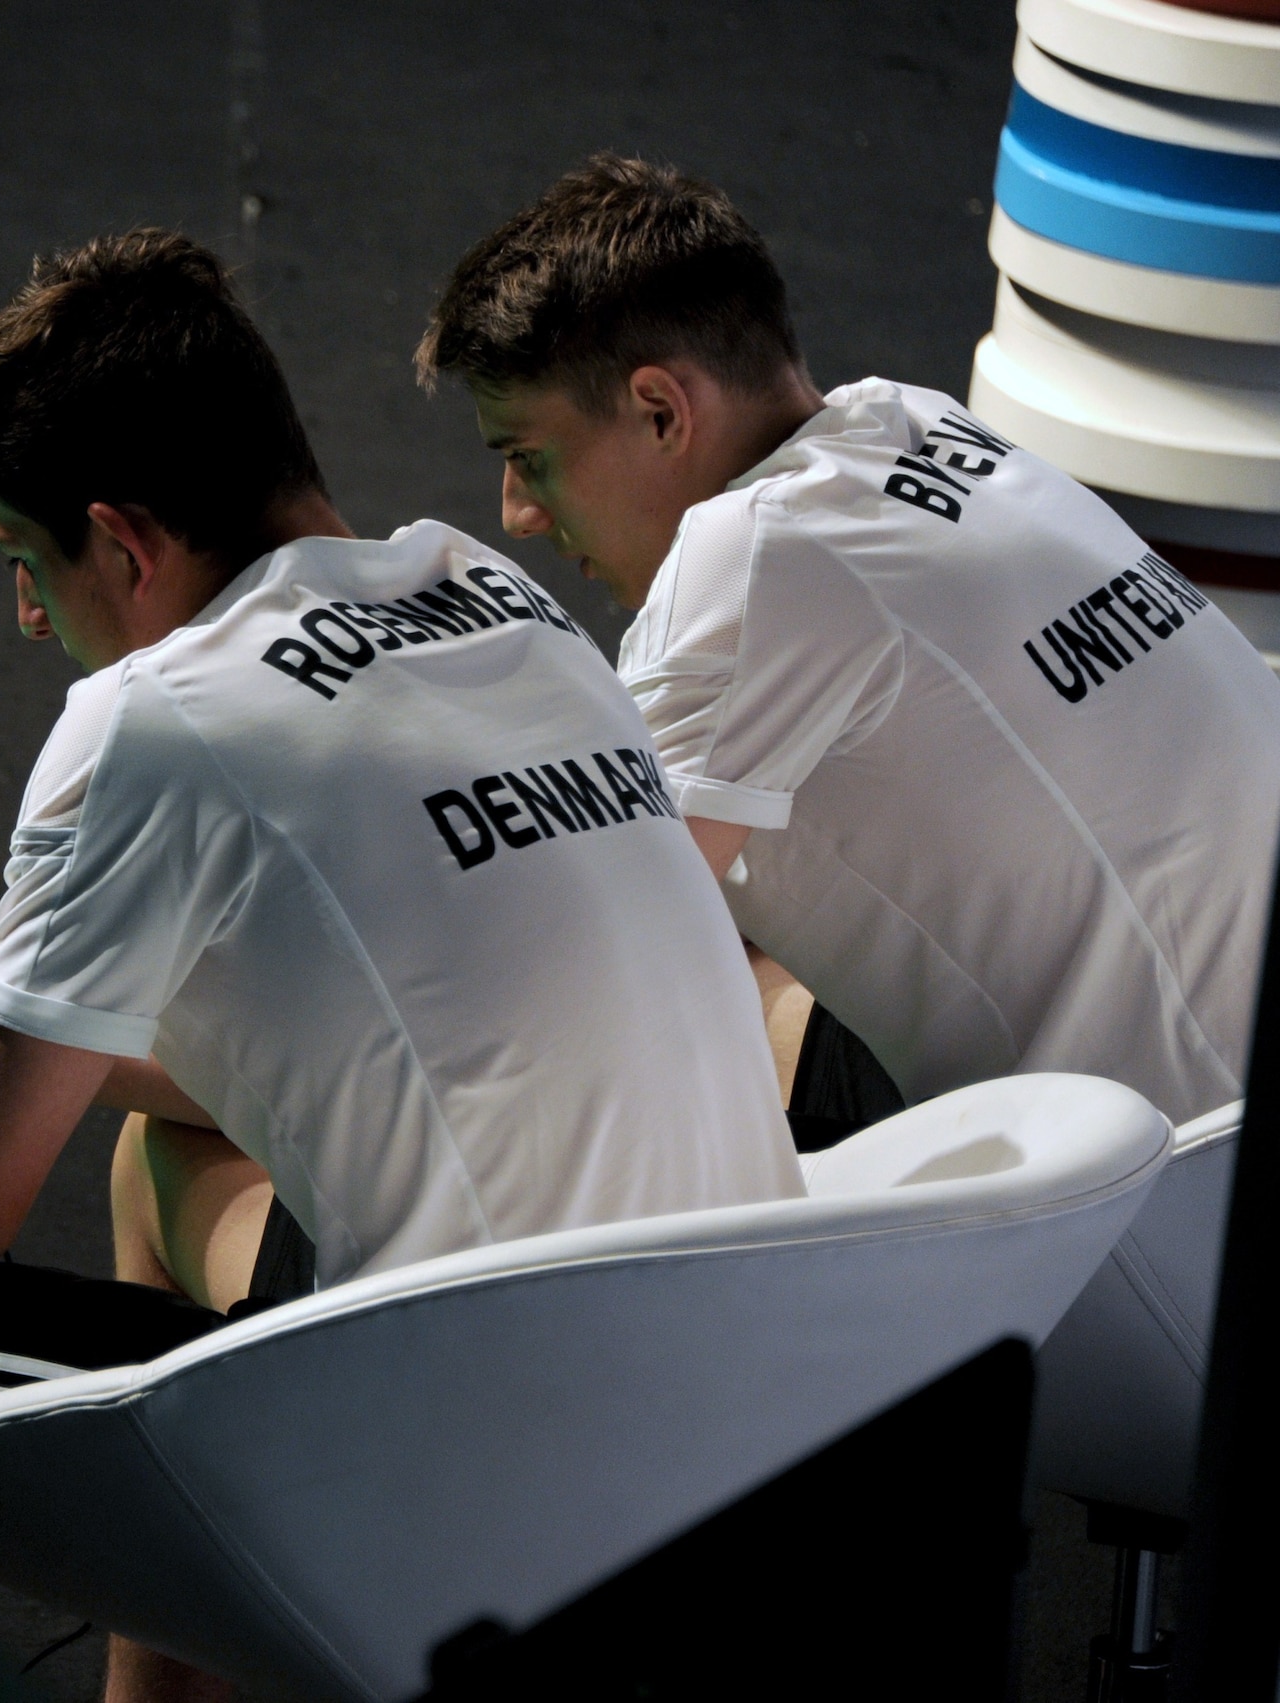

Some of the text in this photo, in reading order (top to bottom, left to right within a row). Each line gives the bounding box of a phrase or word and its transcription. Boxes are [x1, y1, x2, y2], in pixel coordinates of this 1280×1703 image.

[884, 411, 1023, 524] BYEW
[1024, 568, 1185, 704] UNITED
[422, 748, 683, 871] DENMARK
